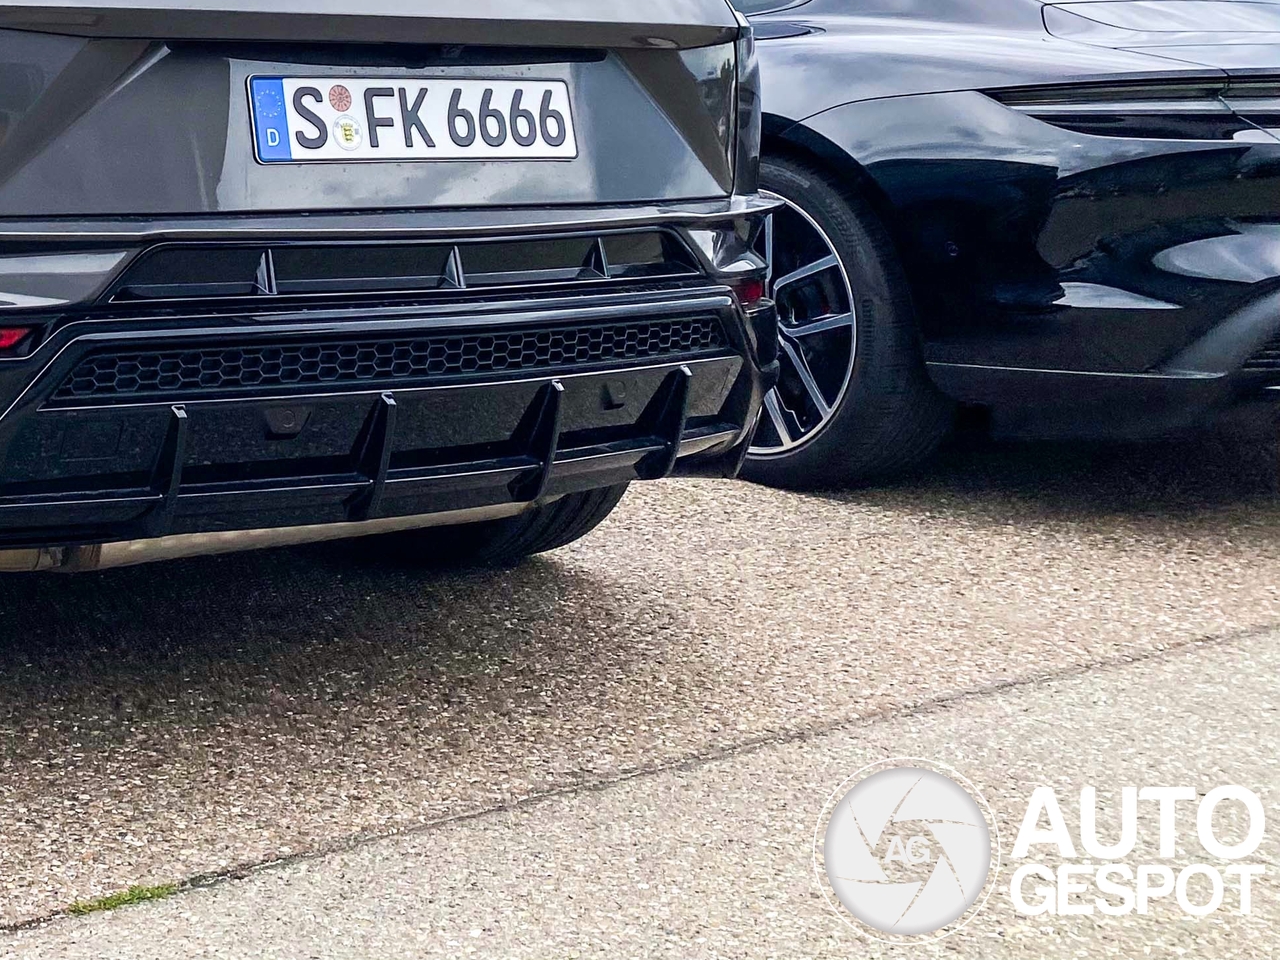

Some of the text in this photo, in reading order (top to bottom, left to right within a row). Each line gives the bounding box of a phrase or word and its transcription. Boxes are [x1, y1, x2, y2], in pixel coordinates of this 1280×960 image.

[266, 128, 280, 147] D
[292, 86, 567, 149] S FK 6666
